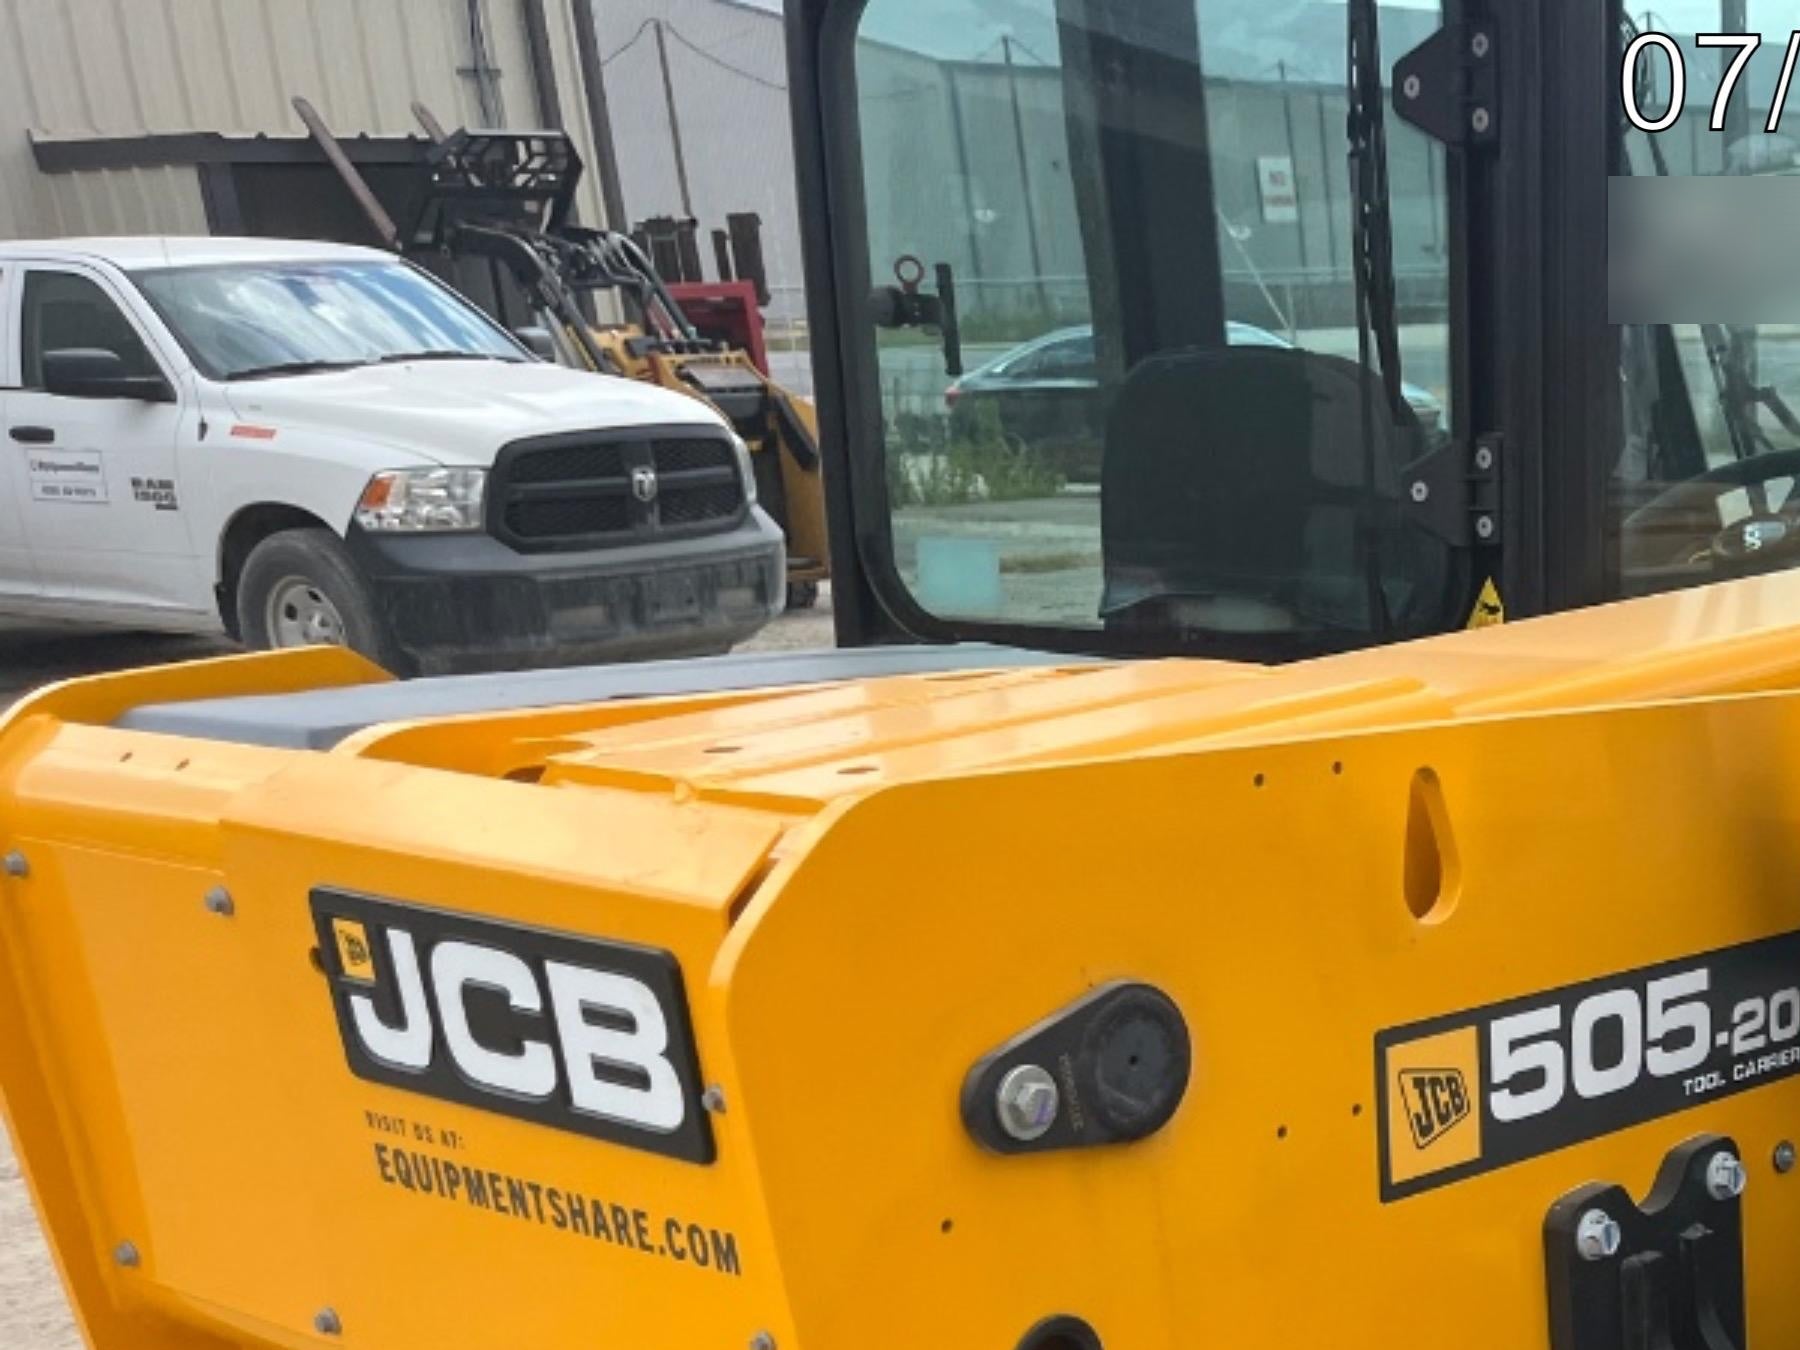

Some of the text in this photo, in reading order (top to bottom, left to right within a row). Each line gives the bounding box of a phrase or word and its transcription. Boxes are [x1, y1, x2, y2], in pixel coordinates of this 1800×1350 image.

[349, 928, 685, 1134] JCB
[1489, 967, 1800, 1122] 505-20
[1683, 1046, 1800, 1096] TOOL CARRIER
[365, 1110, 465, 1150] VISIT US AT:
[1412, 1070, 1466, 1139] JCB
[374, 1142, 742, 1276] EQUIPMENTSHARE.COM
